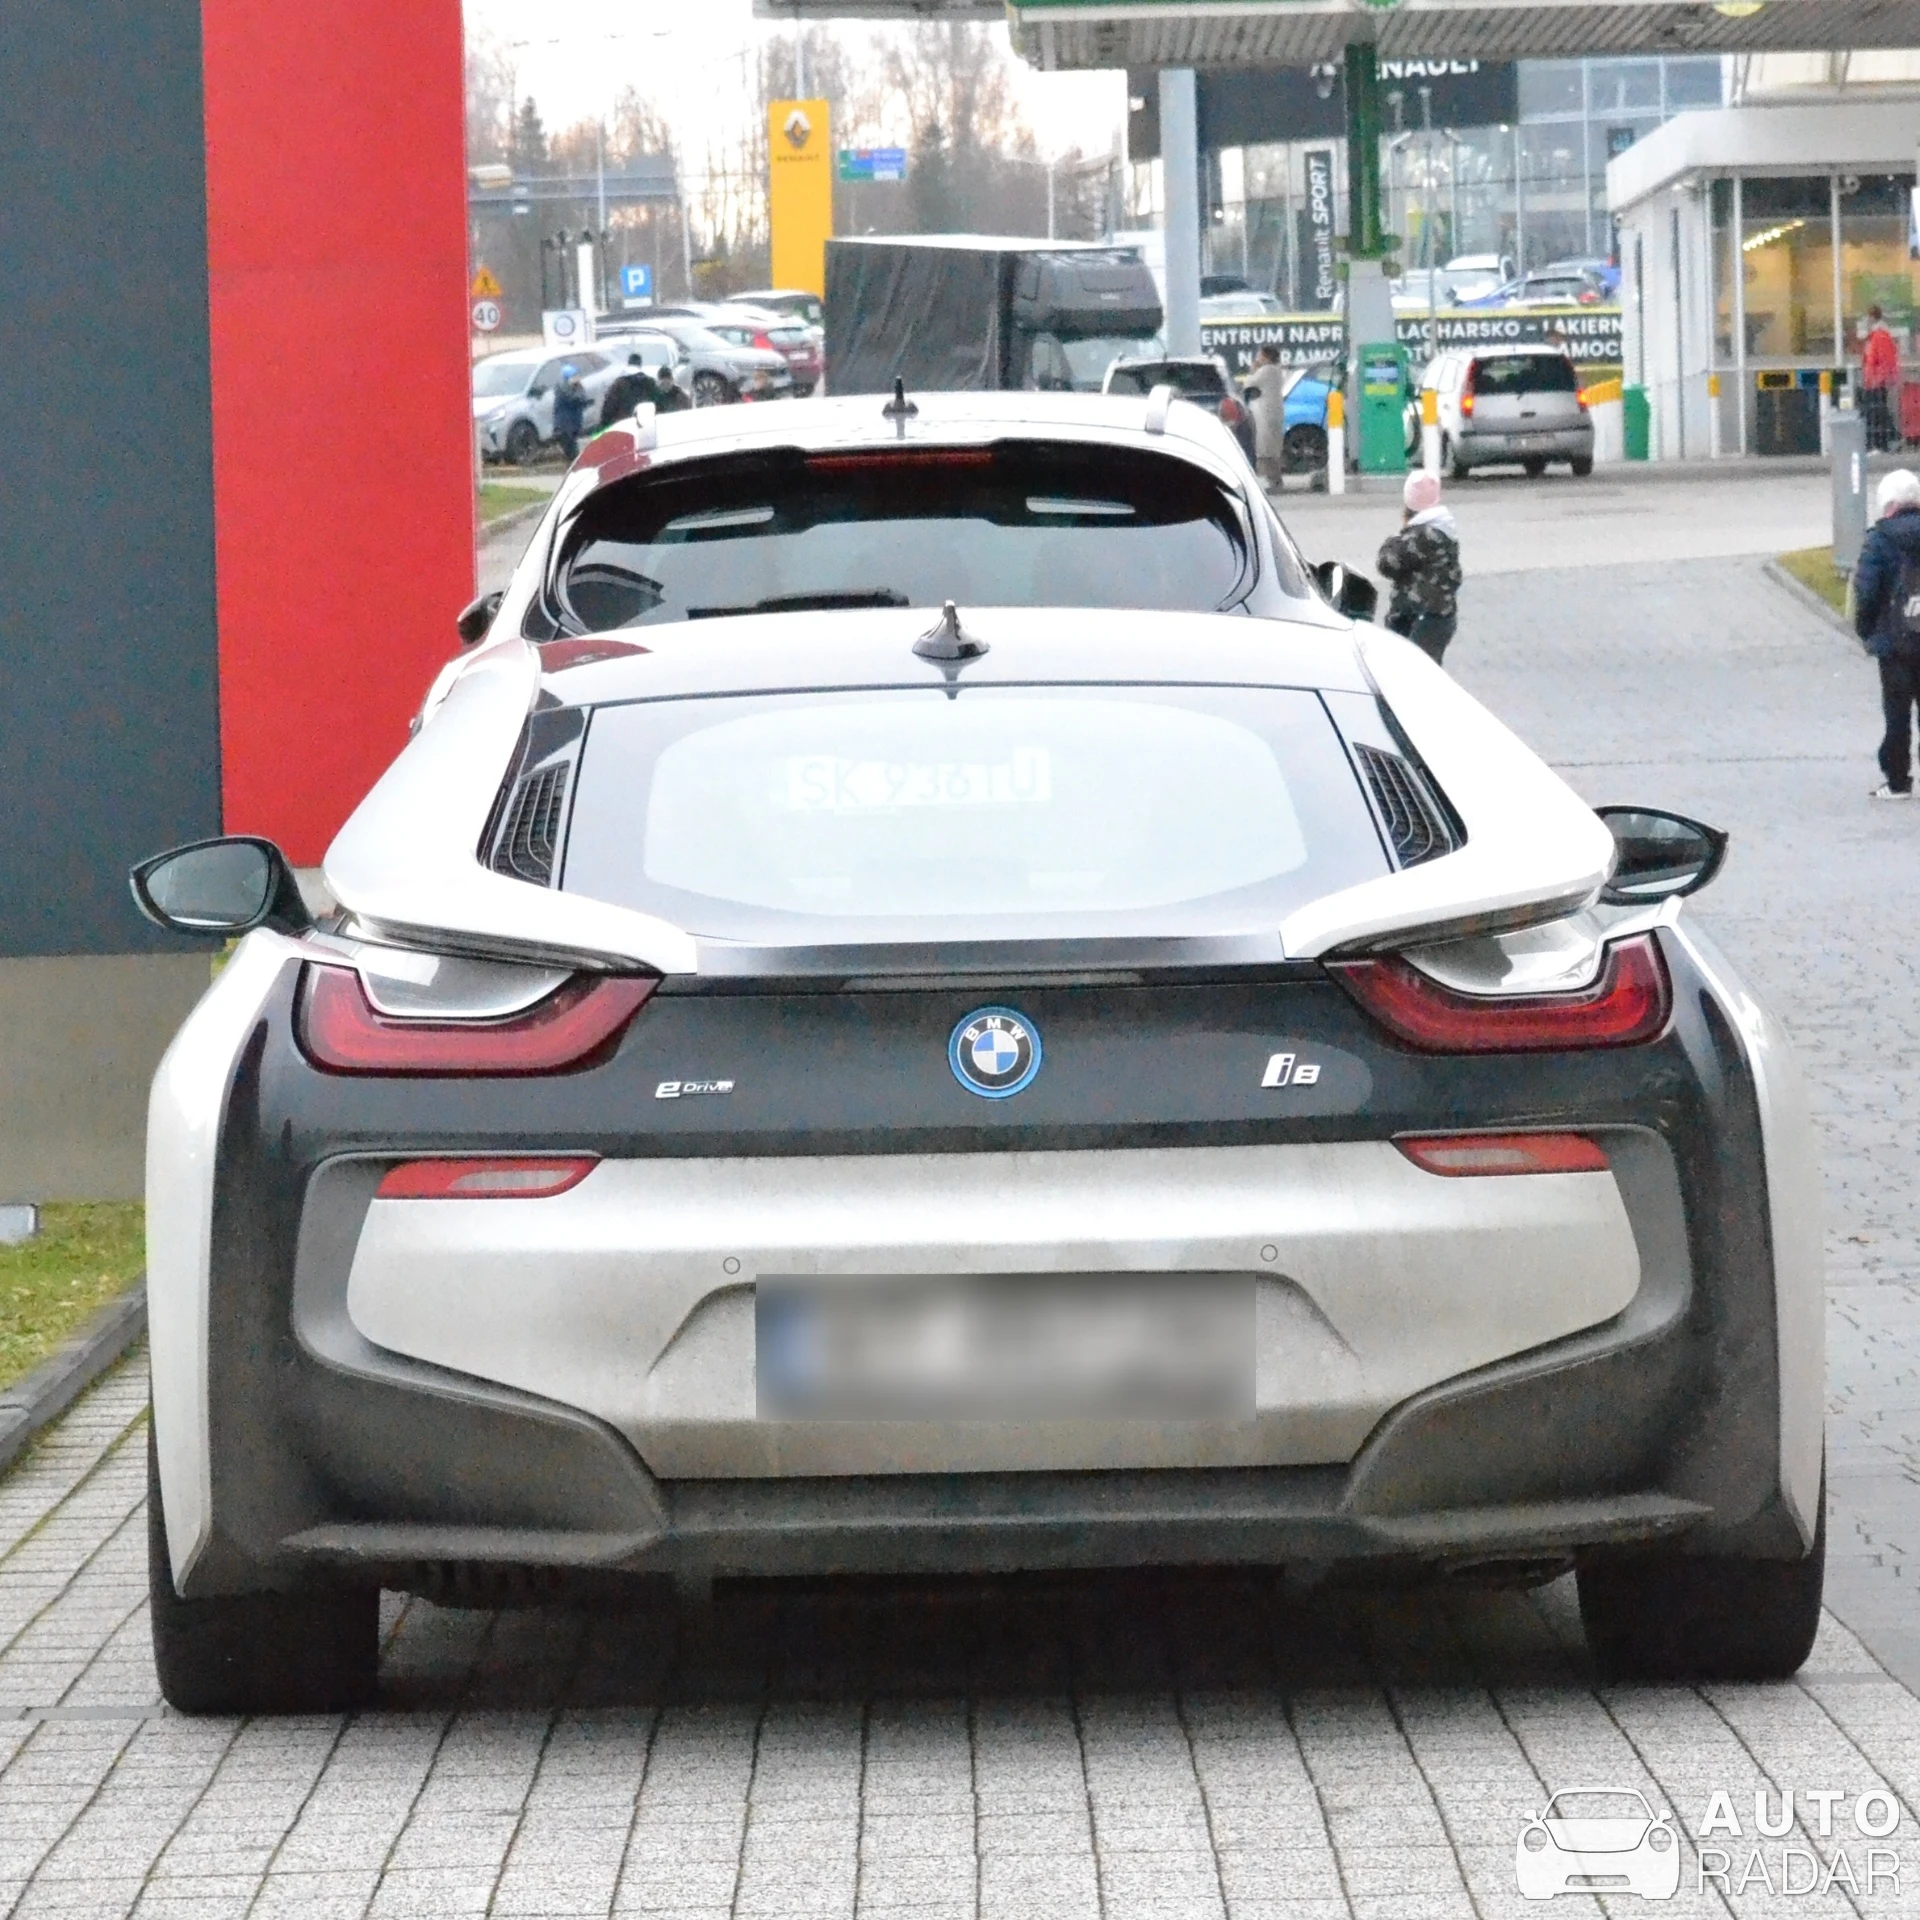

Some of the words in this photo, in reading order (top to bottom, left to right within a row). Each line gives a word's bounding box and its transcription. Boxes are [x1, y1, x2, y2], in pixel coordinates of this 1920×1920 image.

[1310, 156, 1329, 225] SPORT
[1315, 227, 1333, 299] Renault
[627, 268, 646, 293] P
[475, 307, 500, 324] 40
[965, 1017, 1027, 1042] BMW
[1261, 1053, 1321, 1087] i8
